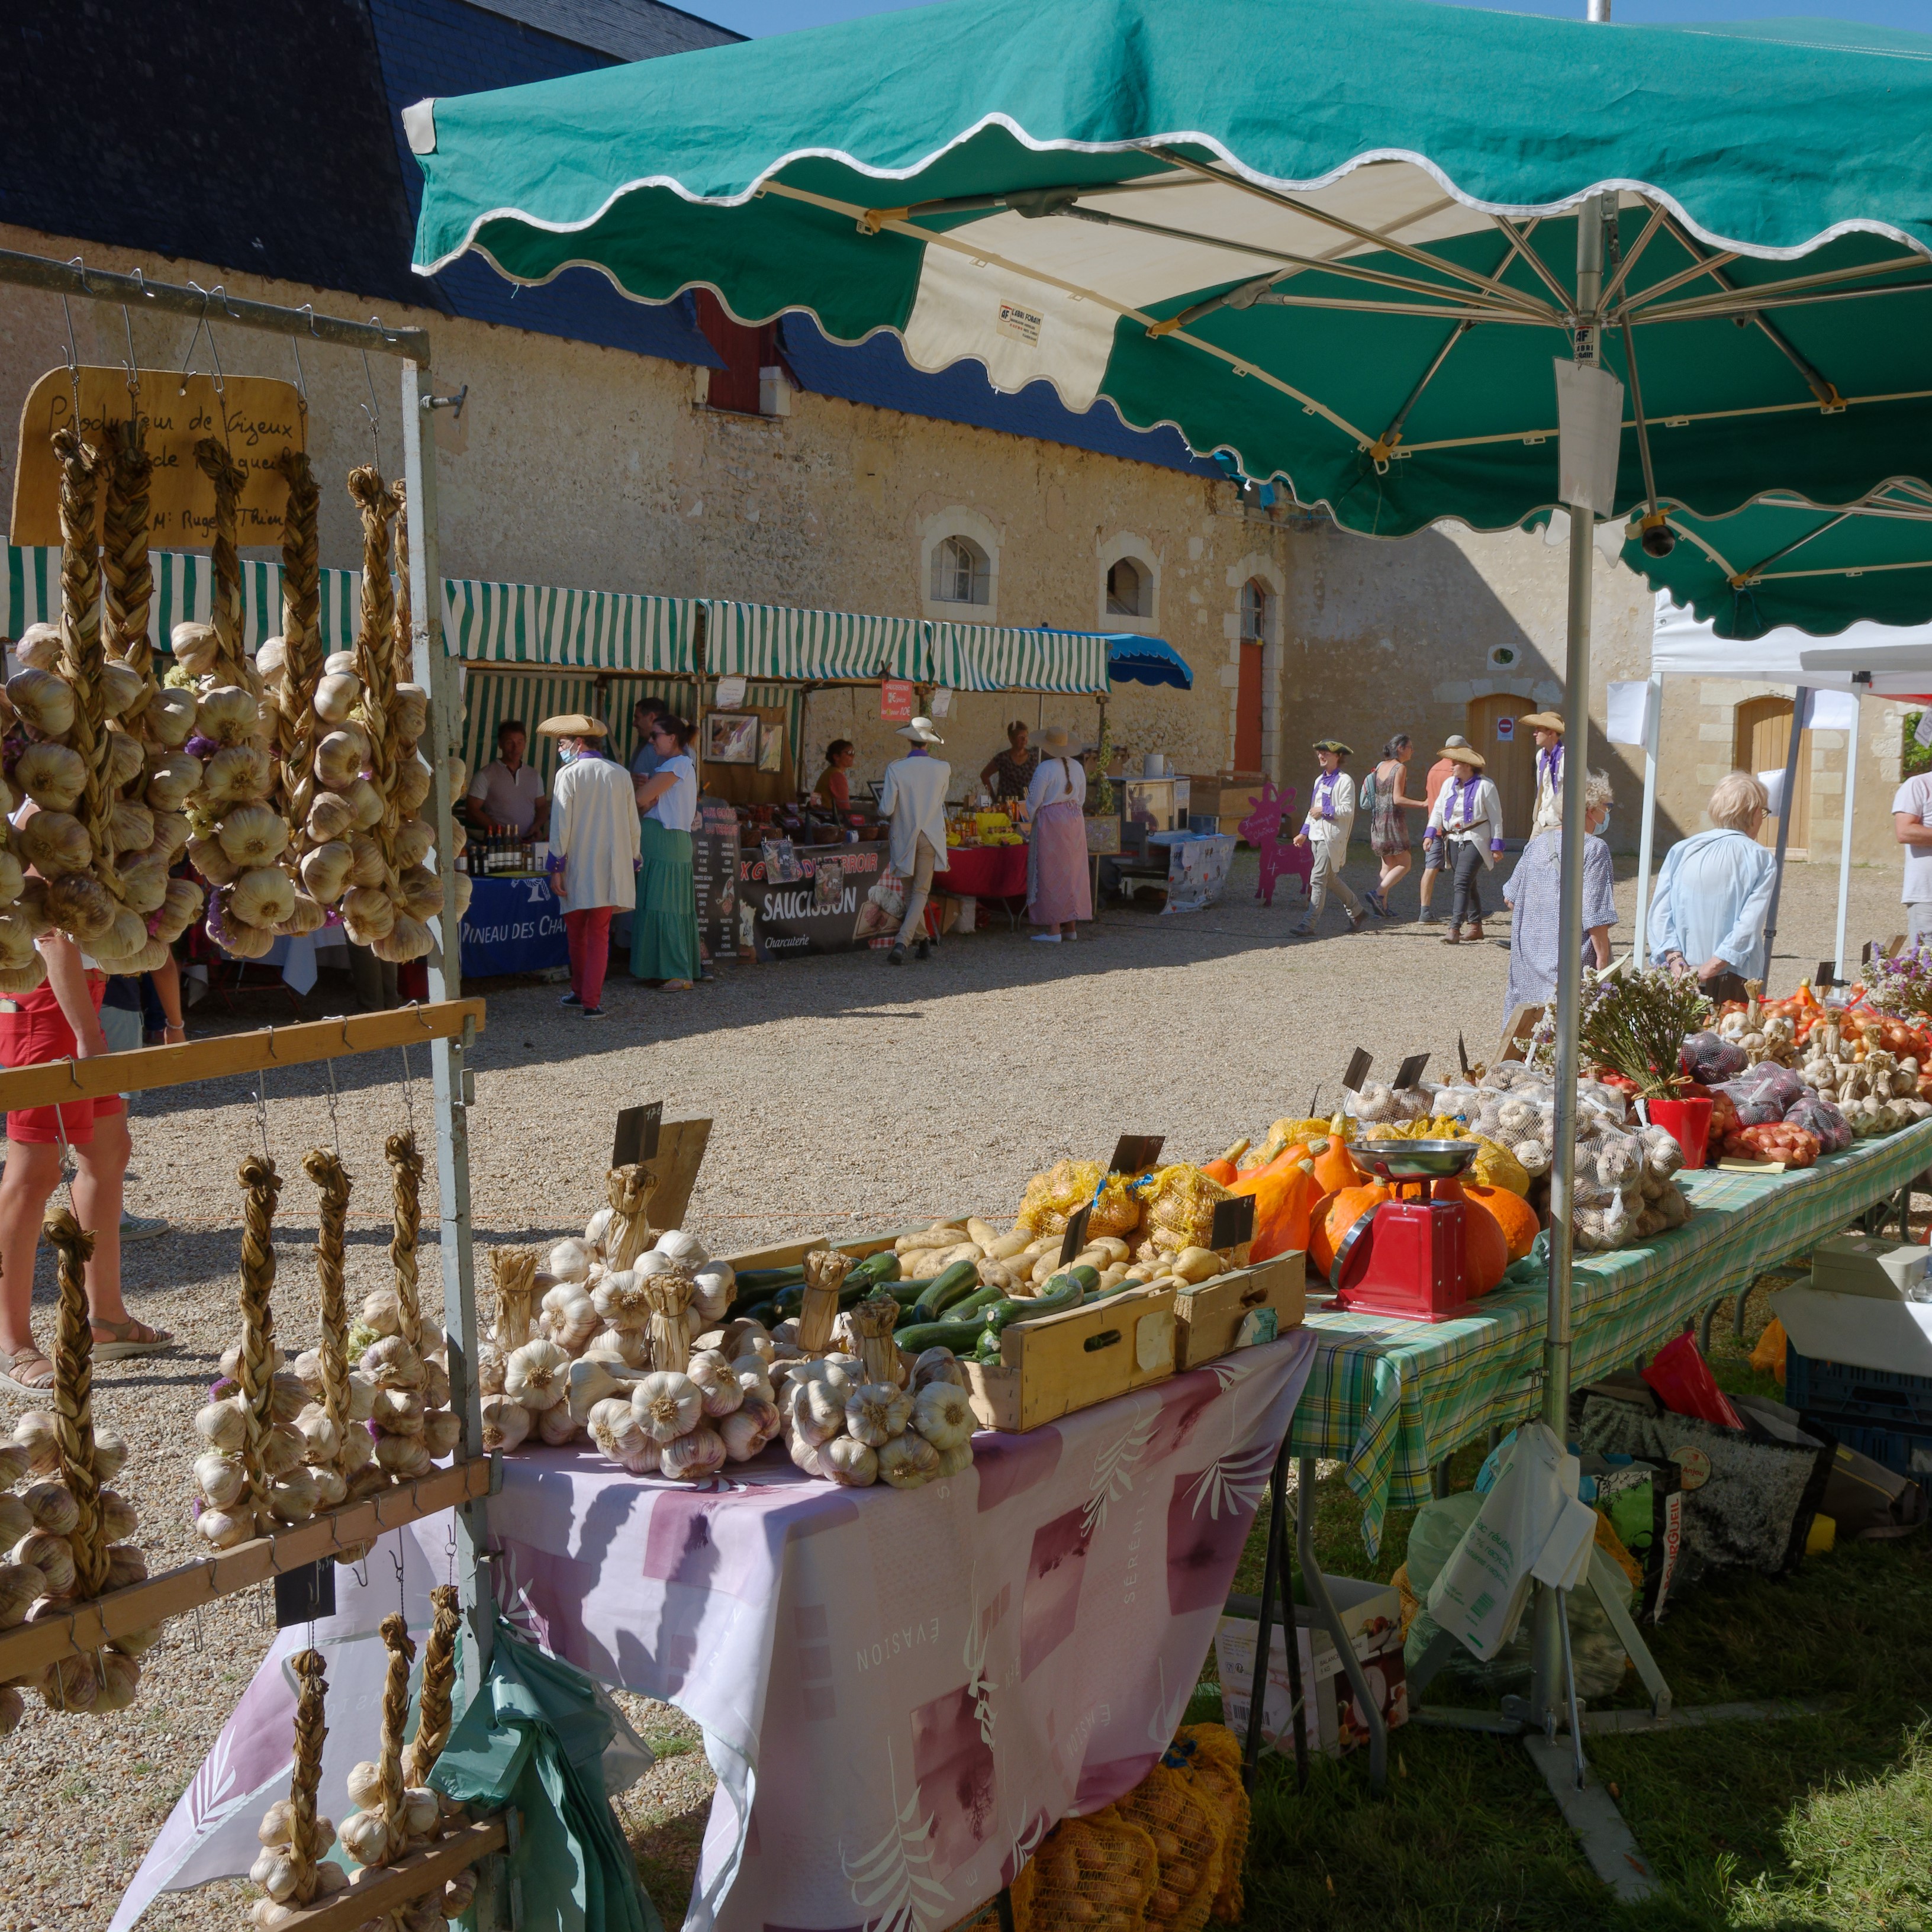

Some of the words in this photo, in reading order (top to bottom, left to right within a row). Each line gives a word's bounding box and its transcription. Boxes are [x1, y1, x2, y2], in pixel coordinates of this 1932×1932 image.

[1001, 309, 1009, 319] AF
[1025, 313, 1041, 326] FORAIN
[1576, 330, 1589, 342] AF
[49, 395, 174, 434] Produteur
[189, 407, 212, 431] de
[153, 445, 180, 468] de
[182, 509, 219, 538] Ruge
[462, 922, 508, 944] PINEAU
[511, 921, 535, 939] DES
[765, 934, 810, 949] Charcuterie
[1682, 1466, 1705, 1477] Anjou
